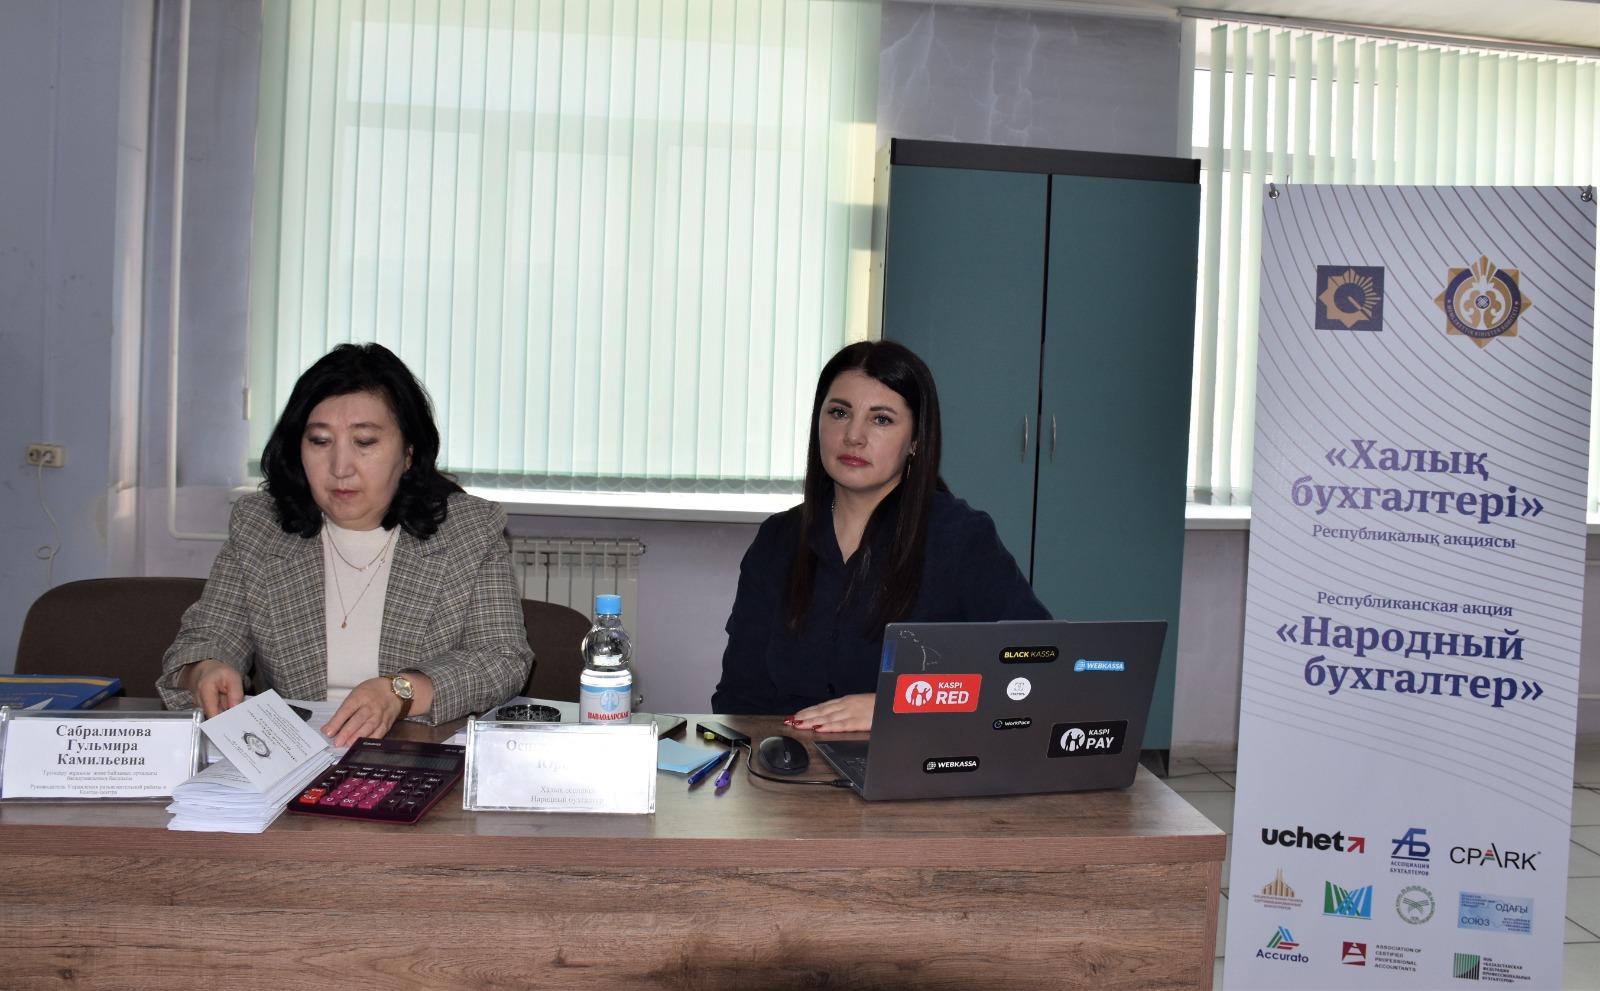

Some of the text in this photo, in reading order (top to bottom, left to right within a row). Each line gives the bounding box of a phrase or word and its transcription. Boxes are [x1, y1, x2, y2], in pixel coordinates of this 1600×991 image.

[1325, 439, 1489, 481] «Халық
[1291, 475, 1544, 524] бухгалтері»
[1312, 524, 1516, 549] Республикалық акциясы
[1317, 591, 1513, 617] Республиканская акция
[1276, 615, 1524, 661] «Народный
[1304, 655, 1544, 708] бухгалтер»
[935, 690, 969, 705] RED
[56, 724, 151, 739] Сабралимова
[1088, 728, 1110, 736] KASPI
[67, 739, 138, 754] Гульмира
[1085, 736, 1115, 749] PAY
[57, 753, 145, 766] Камильевна
[938, 760, 977, 769] WEBKASSA
[1262, 826, 1344, 852] uchet
[1449, 842, 1537, 871] CPARK
[1389, 867, 1429, 876] БУХГАЛТЕРОВ
[1390, 860, 1430, 869] АССОЦИАЦИЯ
[1495, 903, 1528, 914] ОДАҒЫ
[1461, 916, 1490, 926] СОЮЗ
[1376, 944, 1414, 953] ASSOCIATION
[1256, 949, 1309, 963] Accurato
[1374, 957, 1418, 966] PROFESSIONAL
[1374, 964, 1417, 972] ACCOUNTANTS
